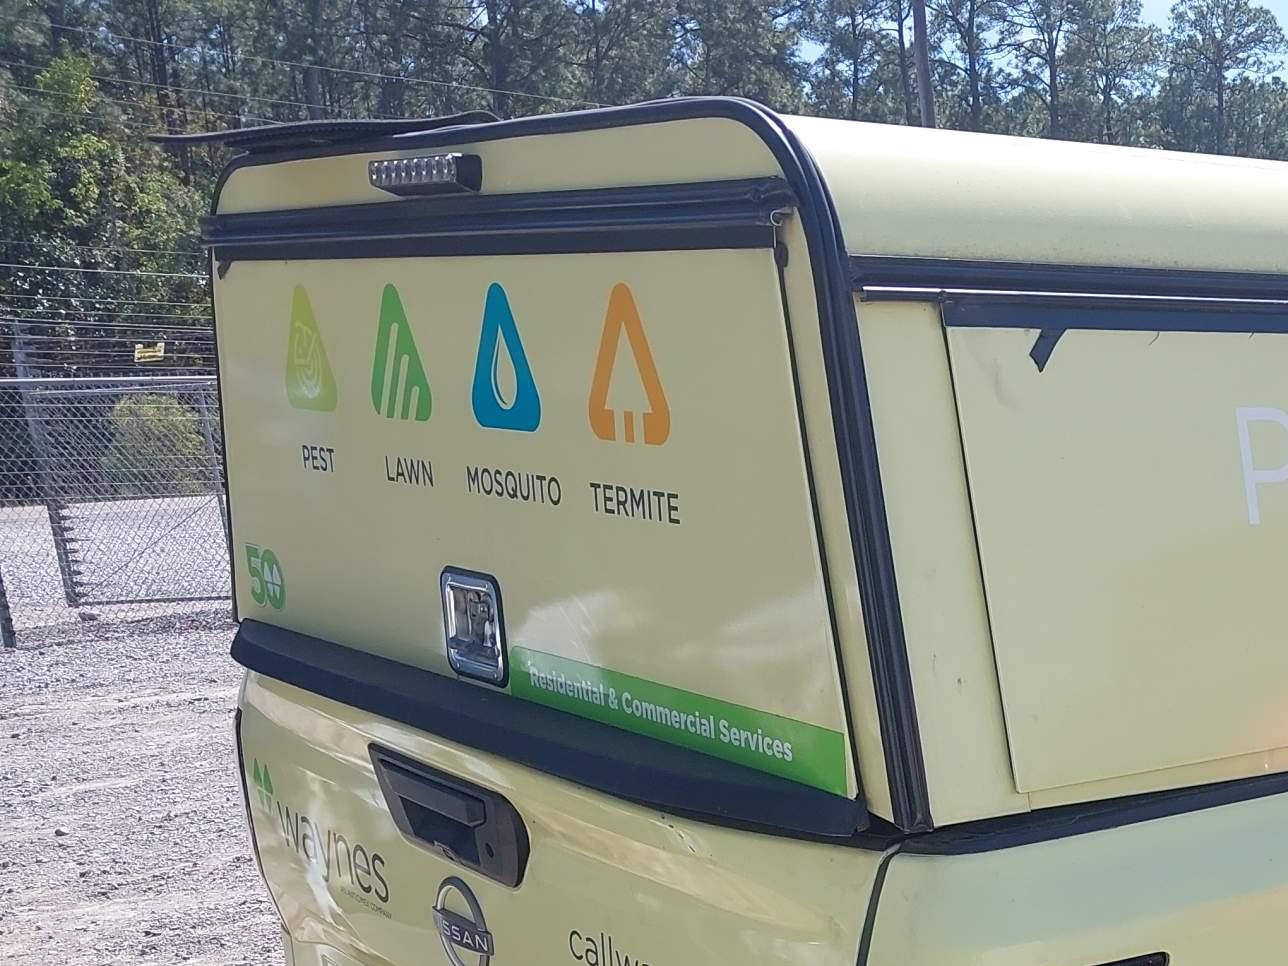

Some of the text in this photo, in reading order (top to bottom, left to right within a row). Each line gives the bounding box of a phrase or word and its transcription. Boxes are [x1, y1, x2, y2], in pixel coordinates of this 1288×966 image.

[302, 444, 335, 473] PEST
[385, 455, 434, 489] LAWN
[466, 465, 562, 507] MOSQUITO
[590, 482, 682, 526] TERMITE
[529, 664, 793, 762] Residential & Commercial Services
[276, 800, 390, 904] waynes
